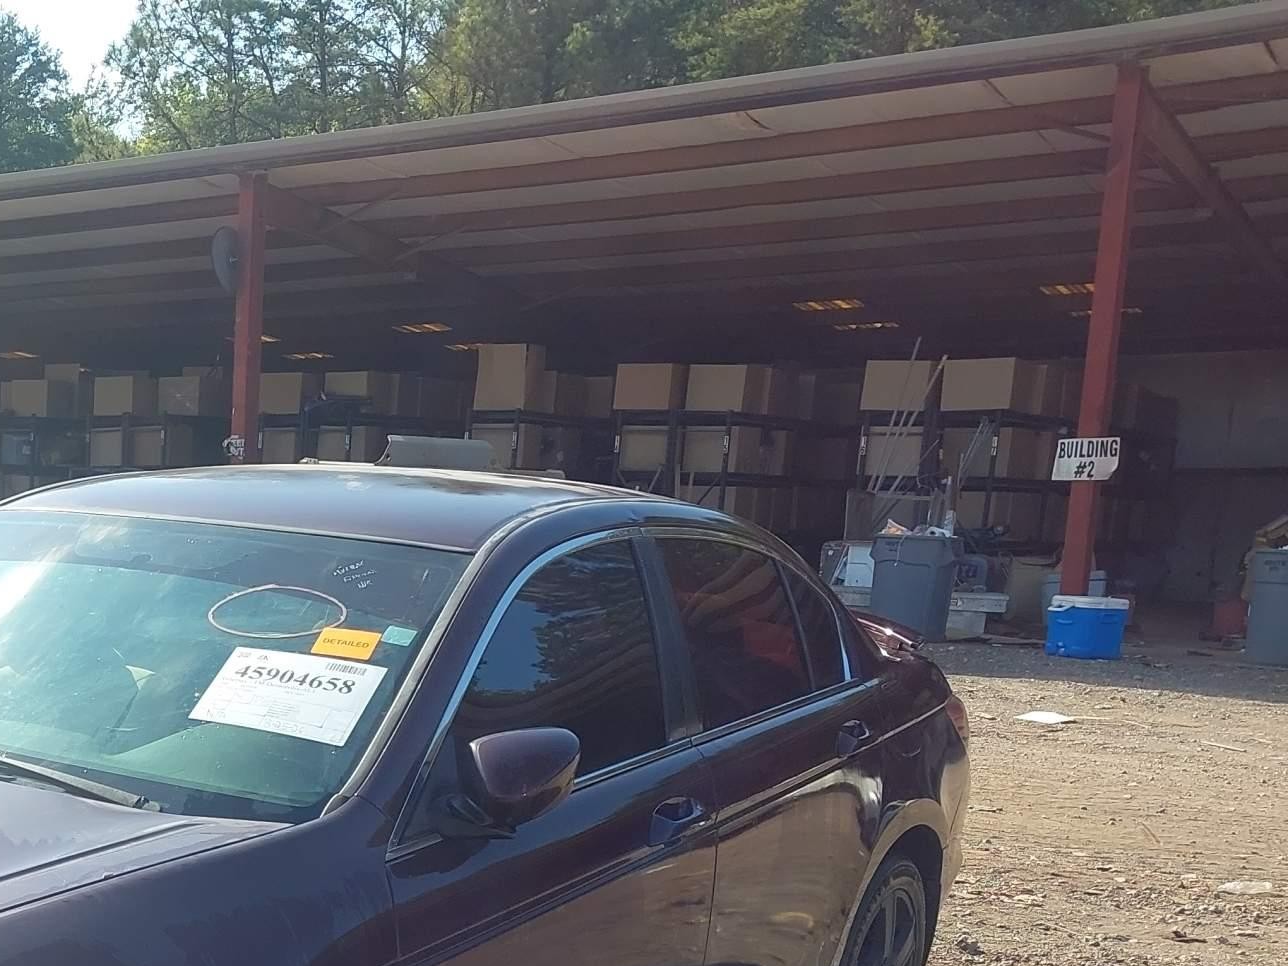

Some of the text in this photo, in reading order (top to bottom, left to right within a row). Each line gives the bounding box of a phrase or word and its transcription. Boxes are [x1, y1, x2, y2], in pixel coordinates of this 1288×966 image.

[1059, 440, 1118, 458] BUILDING
[1074, 461, 1095, 478] #2
[322, 638, 370, 649] DETAILED
[235, 665, 356, 695] 45904658
